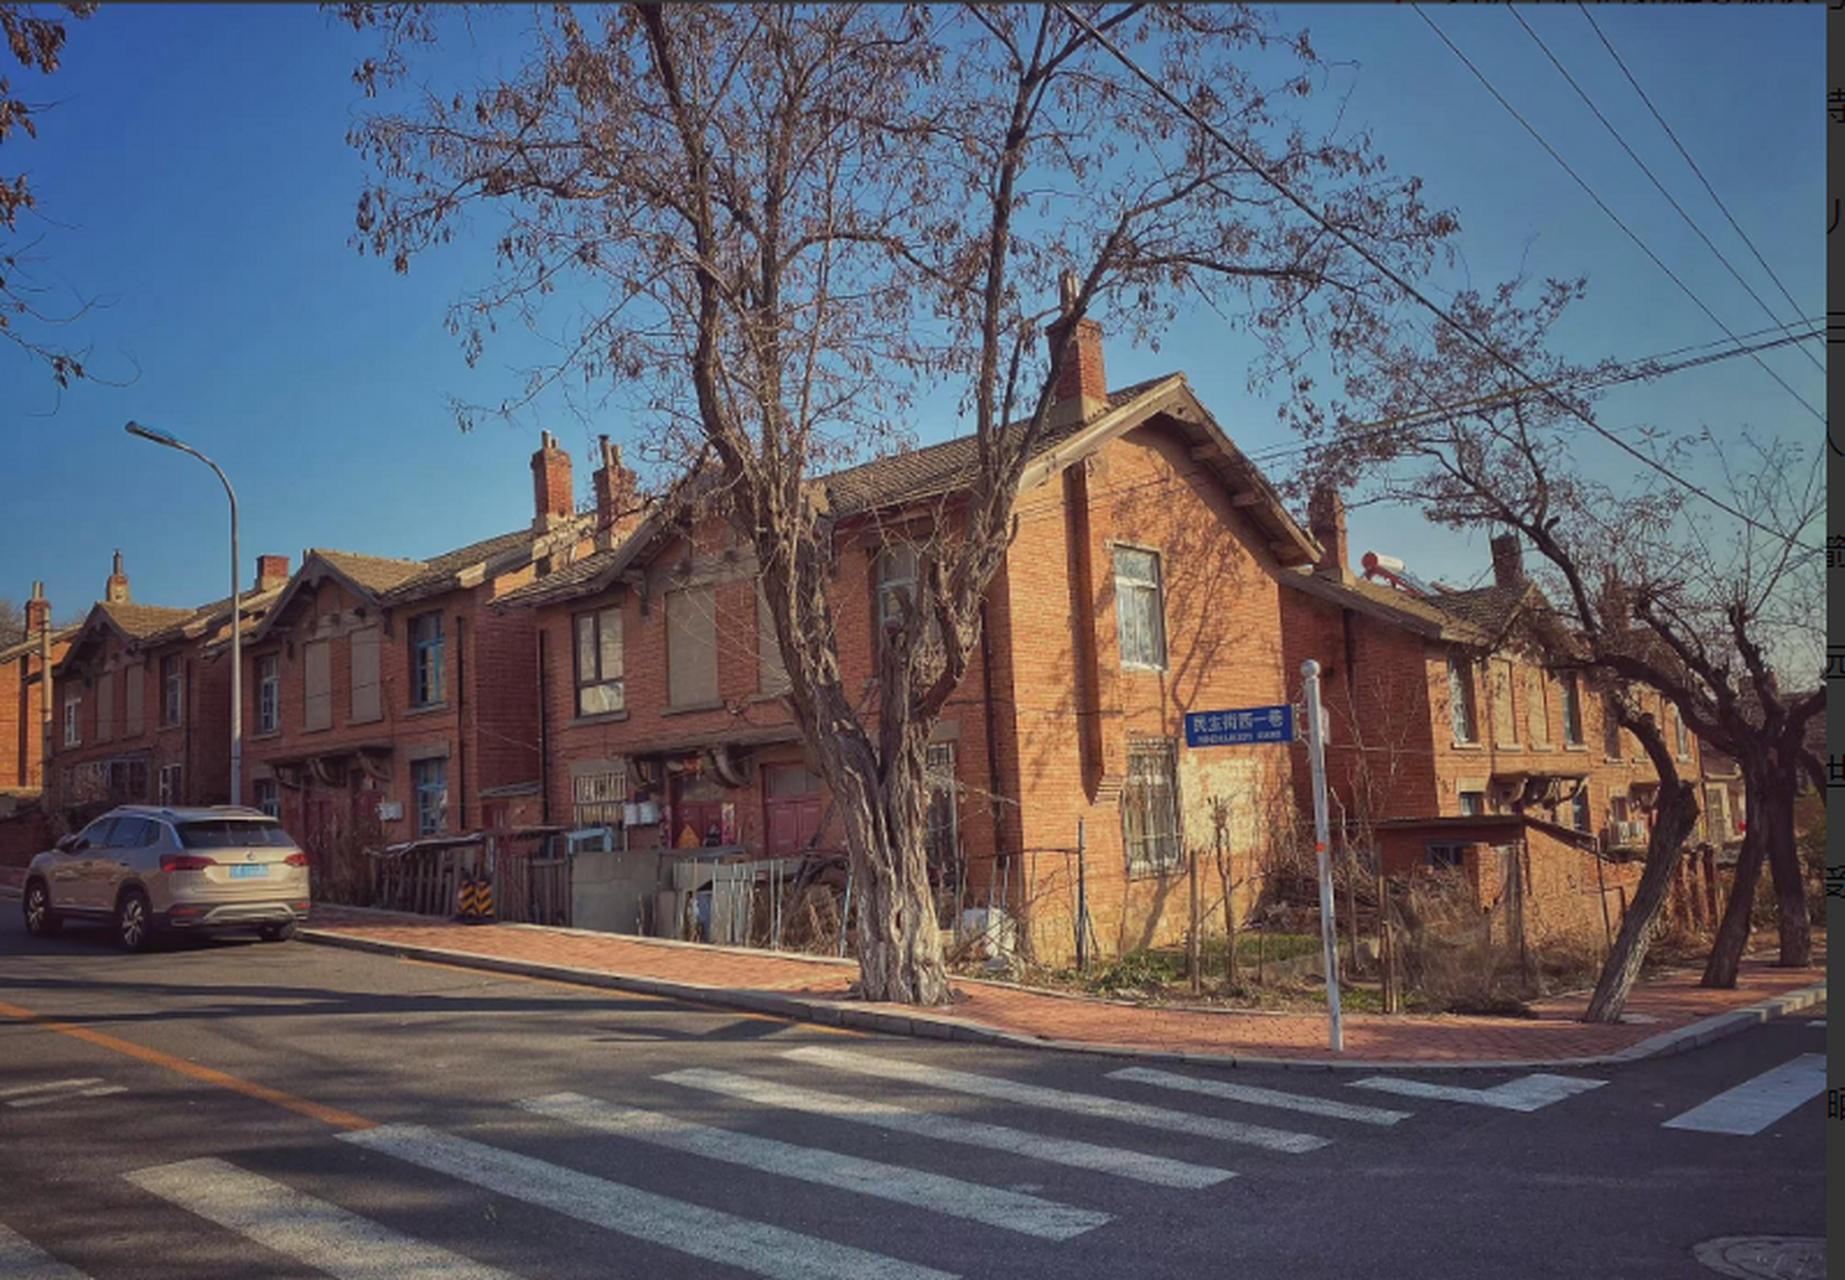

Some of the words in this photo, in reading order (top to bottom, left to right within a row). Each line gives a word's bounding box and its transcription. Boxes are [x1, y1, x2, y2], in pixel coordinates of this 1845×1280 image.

[1194, 709, 1283, 732] 民主街西一巷
